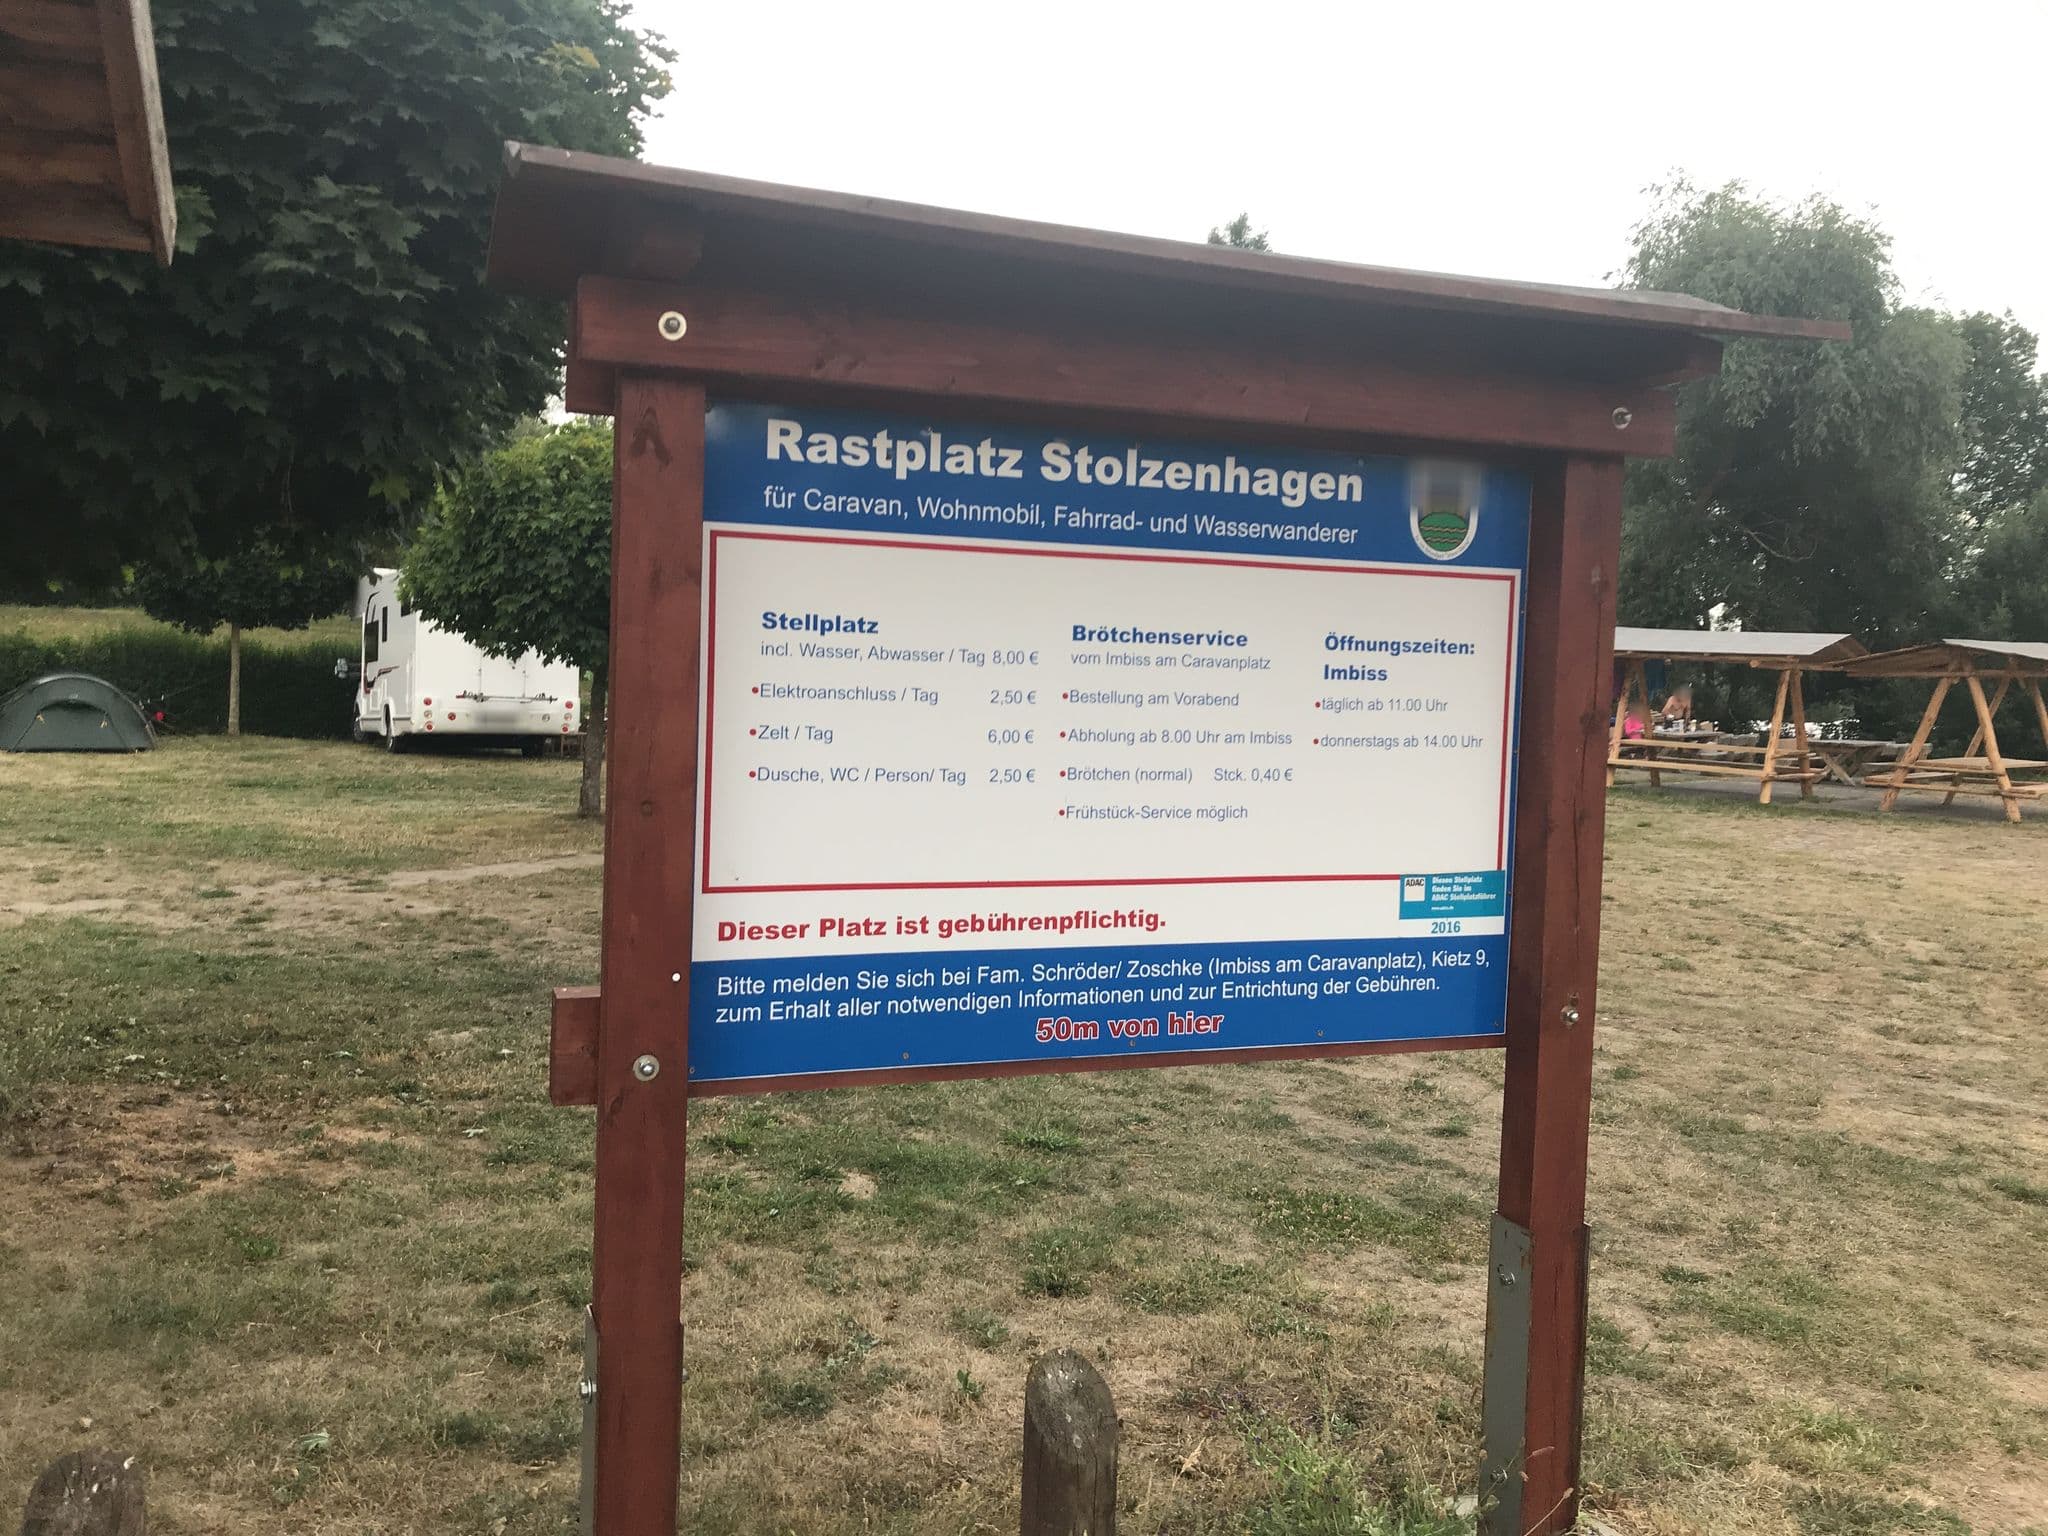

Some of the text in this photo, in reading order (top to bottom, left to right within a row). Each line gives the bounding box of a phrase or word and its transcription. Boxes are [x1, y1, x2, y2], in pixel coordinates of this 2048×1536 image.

[765, 418, 1364, 507] Rastplatz Stolzenhagen
[763, 485, 1358, 545] für Caravan, Wohnmobil, Fahrrad- und Wasserwanderer
[761, 611, 879, 636] Stellplatz
[1071, 625, 1249, 647] Brötchenservice
[1324, 631, 1476, 656] Öffnungszeiten:
[760, 641, 793, 658] incl.
[799, 643, 863, 661] Wasser,
[867, 645, 945, 663] Abwasser
[958, 648, 986, 667] Tag
[992, 650, 1025, 666] 8,00
[1029, 651, 1039, 665] €
[1071, 652, 1271, 671] vom Imbiss am Caravanplatz
[1323, 664, 1388, 682] Imbiss
[760, 684, 896, 702] Elektroanschluss
[911, 687, 939, 705] Tag
[990, 690, 1023, 706] 2,50
[1026, 690, 1037, 705] €
[1069, 690, 1240, 708] Bestellung am Vorabend
[1322, 697, 1448, 714] täglich ab 11.00 Uhr
[758, 725, 789, 741] Zelt
[805, 726, 834, 744] Tag
[987, 729, 1020, 745] 6,00
[1024, 729, 1034, 744] €
[1068, 728, 1293, 746] Abholung ab 8.00 Uhr am Imbiss
[1320, 734, 1483, 751] donnerstags ab 14.00 Uhr
[757, 767, 824, 785] Dusche,
[829, 767, 859, 782] WC
[875, 768, 934, 783] Person/
[939, 769, 967, 786] Tag
[989, 768, 1022, 785] 2,50
[1026, 769, 1036, 783] €
[1067, 767, 1294, 785] Brötchen (normal) Stck. 0,40 €
[1066, 804, 1248, 822] Frühstück-Service möglich
[1405, 878, 1425, 887] ADAC
[717, 909, 1167, 942] Dieser Platz ist gebührenpflichtig.
[1431, 921, 1461, 934] 2016
[717, 949, 1490, 996] Bitte melden Sie sich bei Fam. Schröder/ Zoschke (Imbiss am Caravanplatz), Kietz 9,
[715, 975, 1441, 1024] zum Erhalt aller notwendigen Informationen und zur Entrichtung der Gebühren.
[1034, 1010, 1225, 1043] 50m von hier
